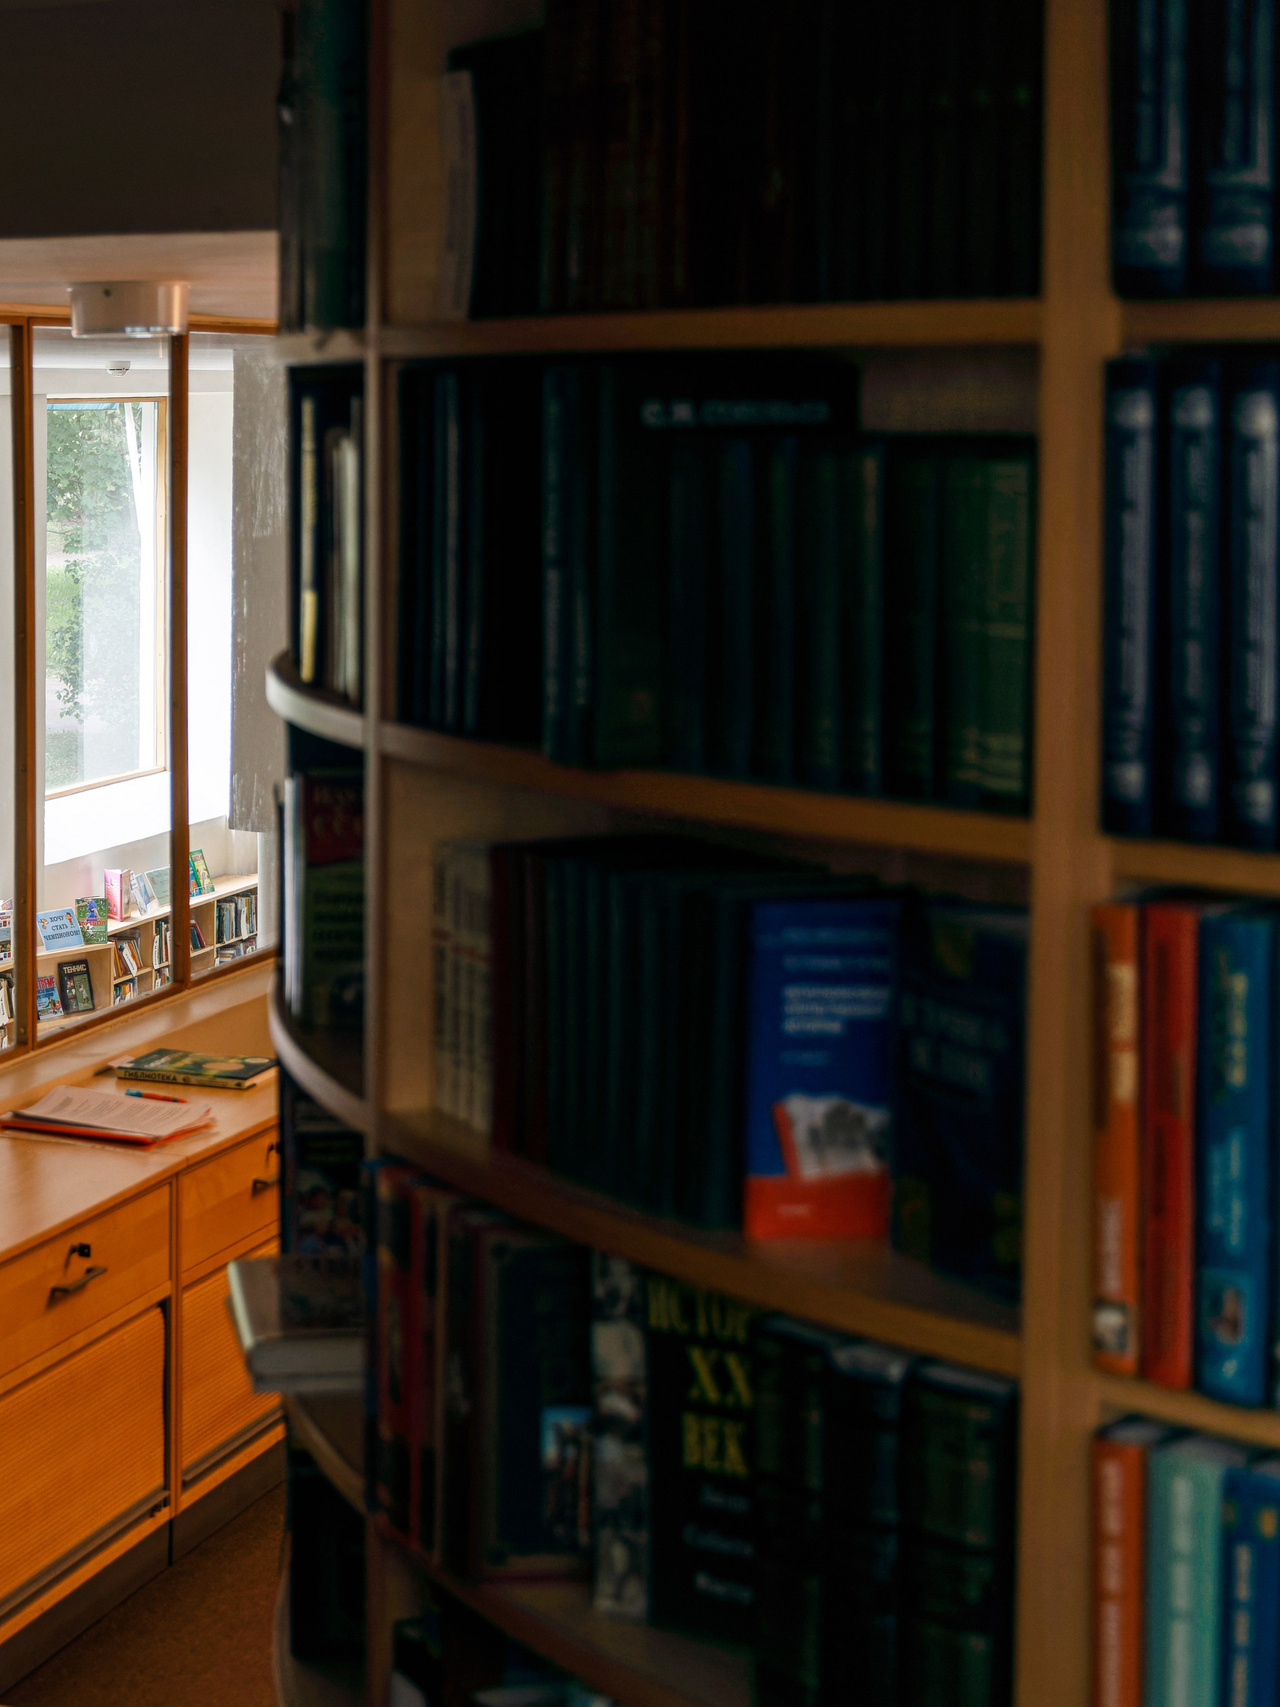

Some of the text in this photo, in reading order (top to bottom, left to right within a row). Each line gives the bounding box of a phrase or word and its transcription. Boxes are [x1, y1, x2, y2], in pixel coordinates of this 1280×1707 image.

[52, 924, 68, 932] СТАТЬ
[36, 976, 56, 989] TREME
[62, 964, 87, 974] ТЕННИС
[647, 1276, 751, 1344] ИСТОР
[686, 1345, 754, 1409] XX
[681, 1411, 750, 1479] ВЕК
